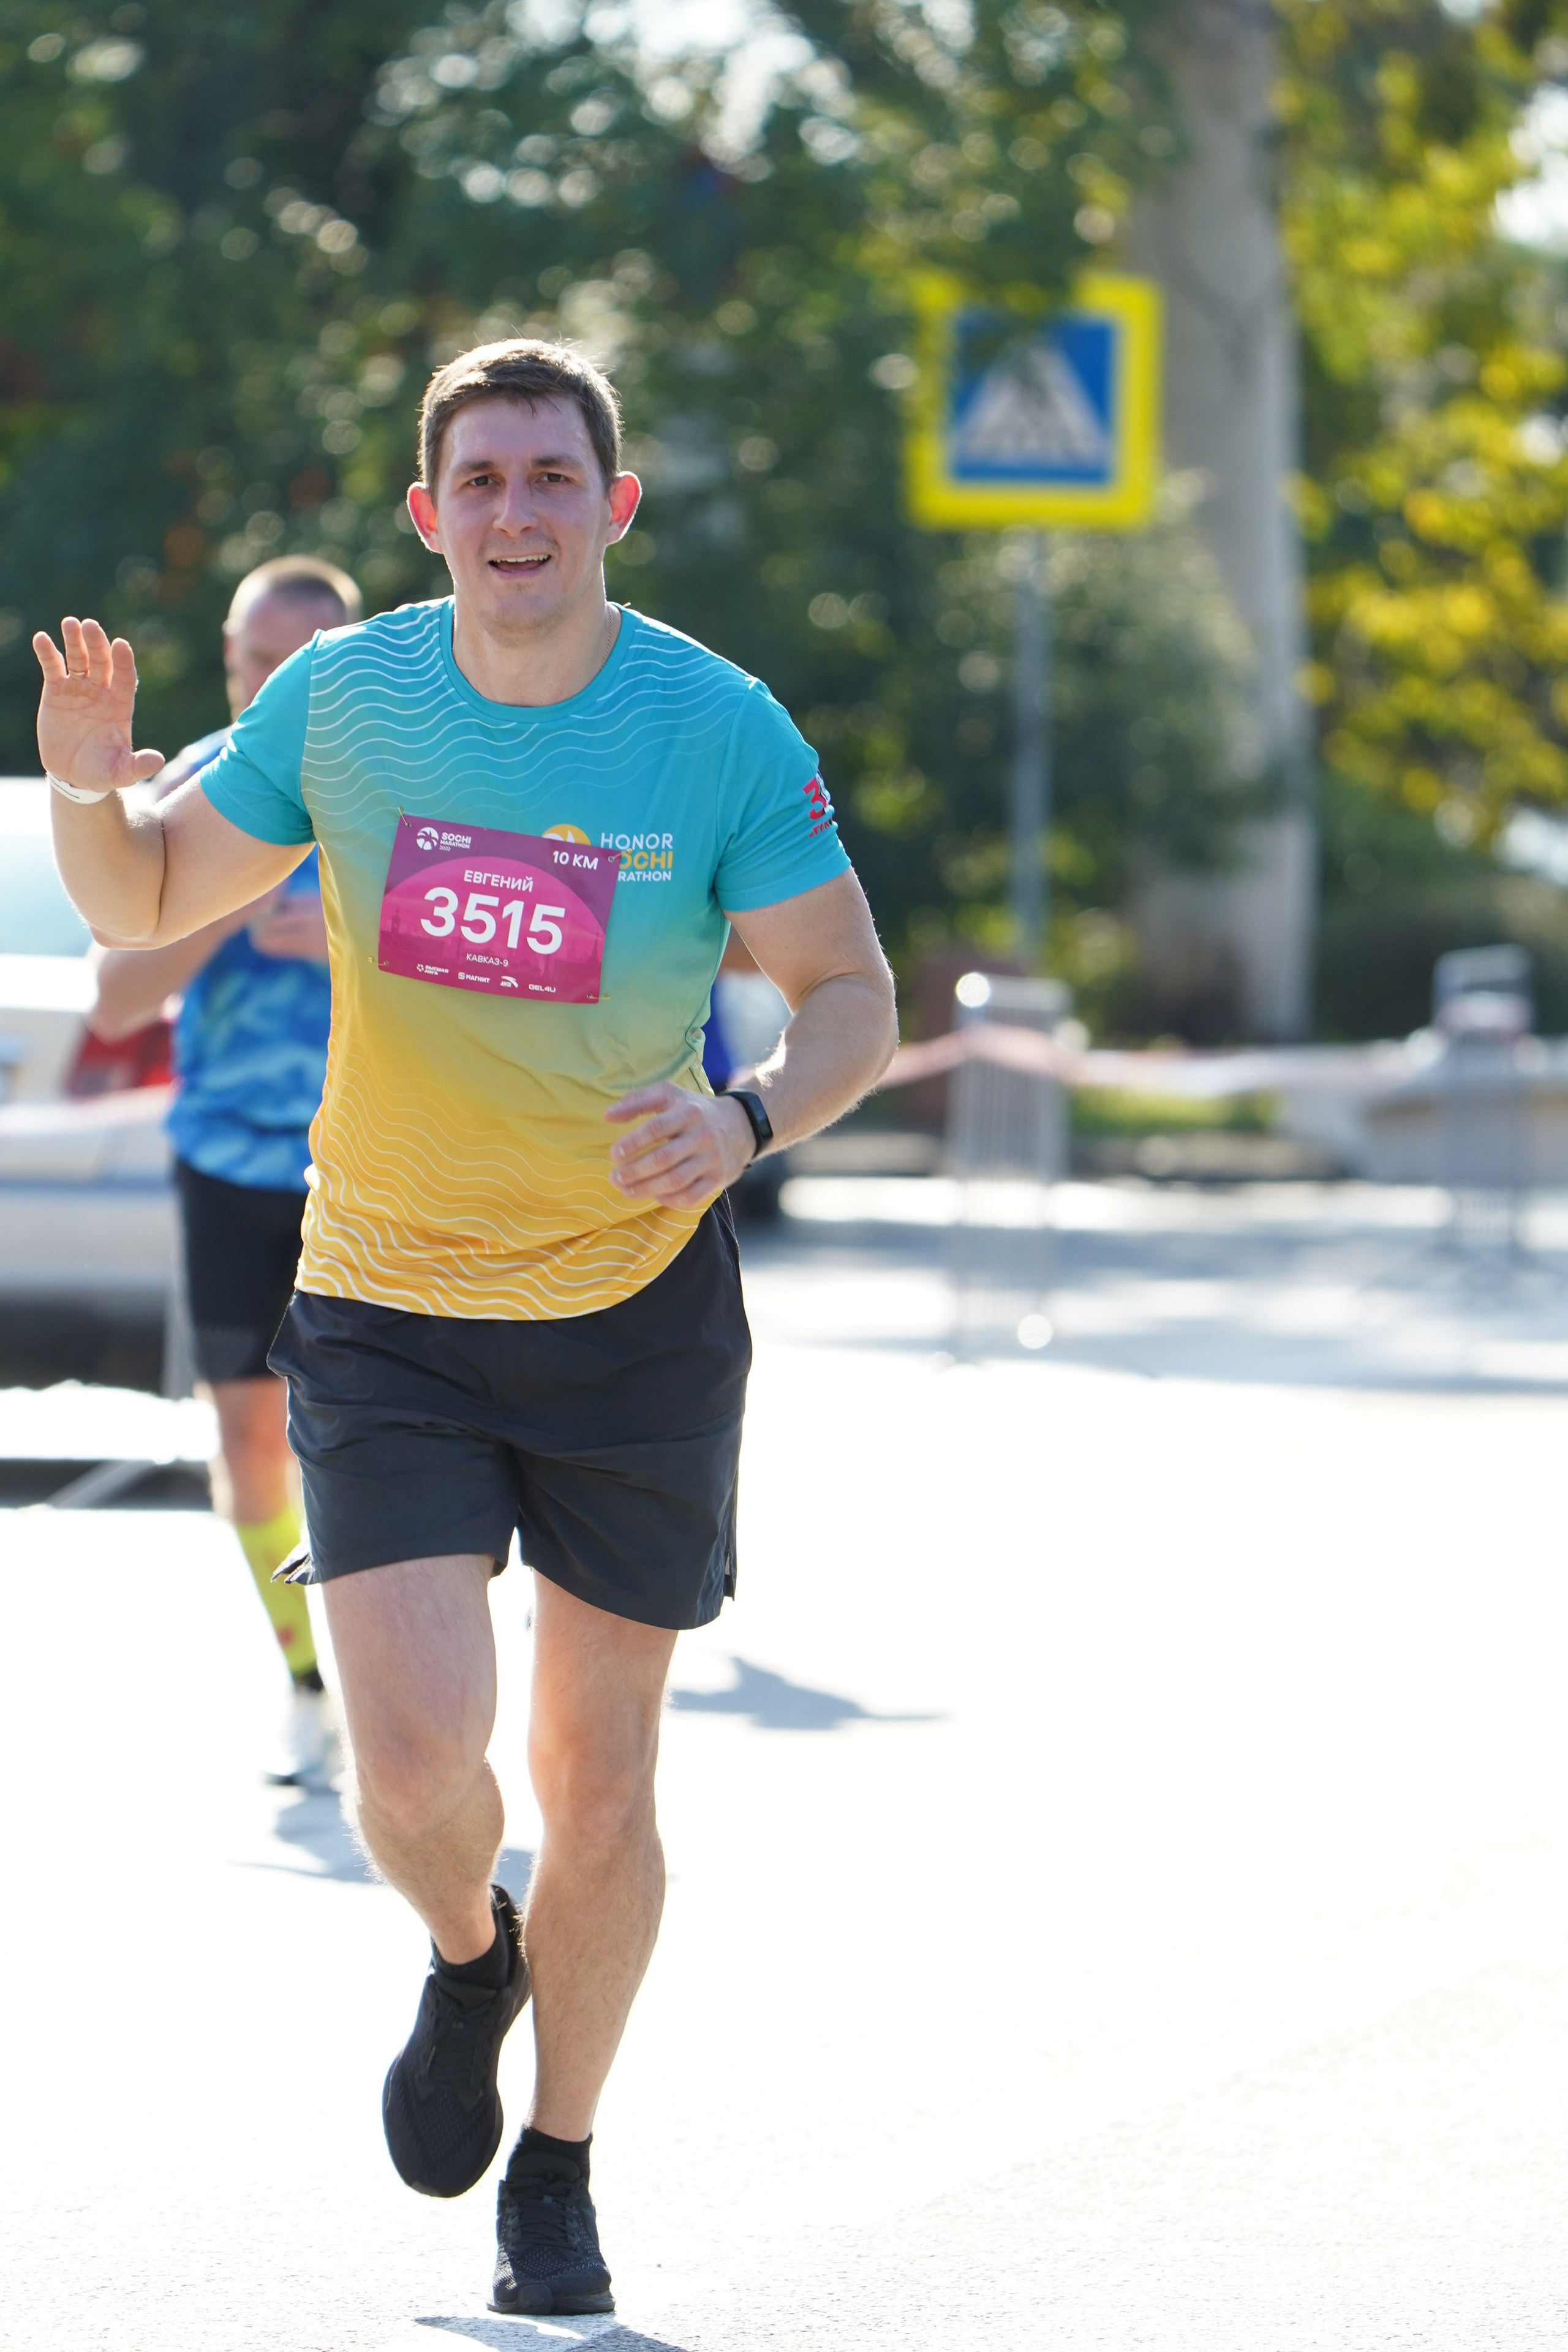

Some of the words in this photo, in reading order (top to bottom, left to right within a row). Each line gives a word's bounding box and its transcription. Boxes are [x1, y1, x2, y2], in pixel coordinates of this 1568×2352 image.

[440, 840, 470, 849] MARATHON
[441, 832, 472, 844] SOCHI
[600, 832, 673, 850] HONOR
[552, 850, 569, 865] 10
[619, 851, 673, 869] OCHI
[464, 869, 533, 892] ЕВГЕНИЙ
[617, 871, 671, 882] RATHON
[420, 886, 565, 954] 3515
[466, 952, 508, 967] КАВКАЗ-9
[466, 974, 490, 983] МАГНИТ
[529, 984, 556, 993] GEL4U
